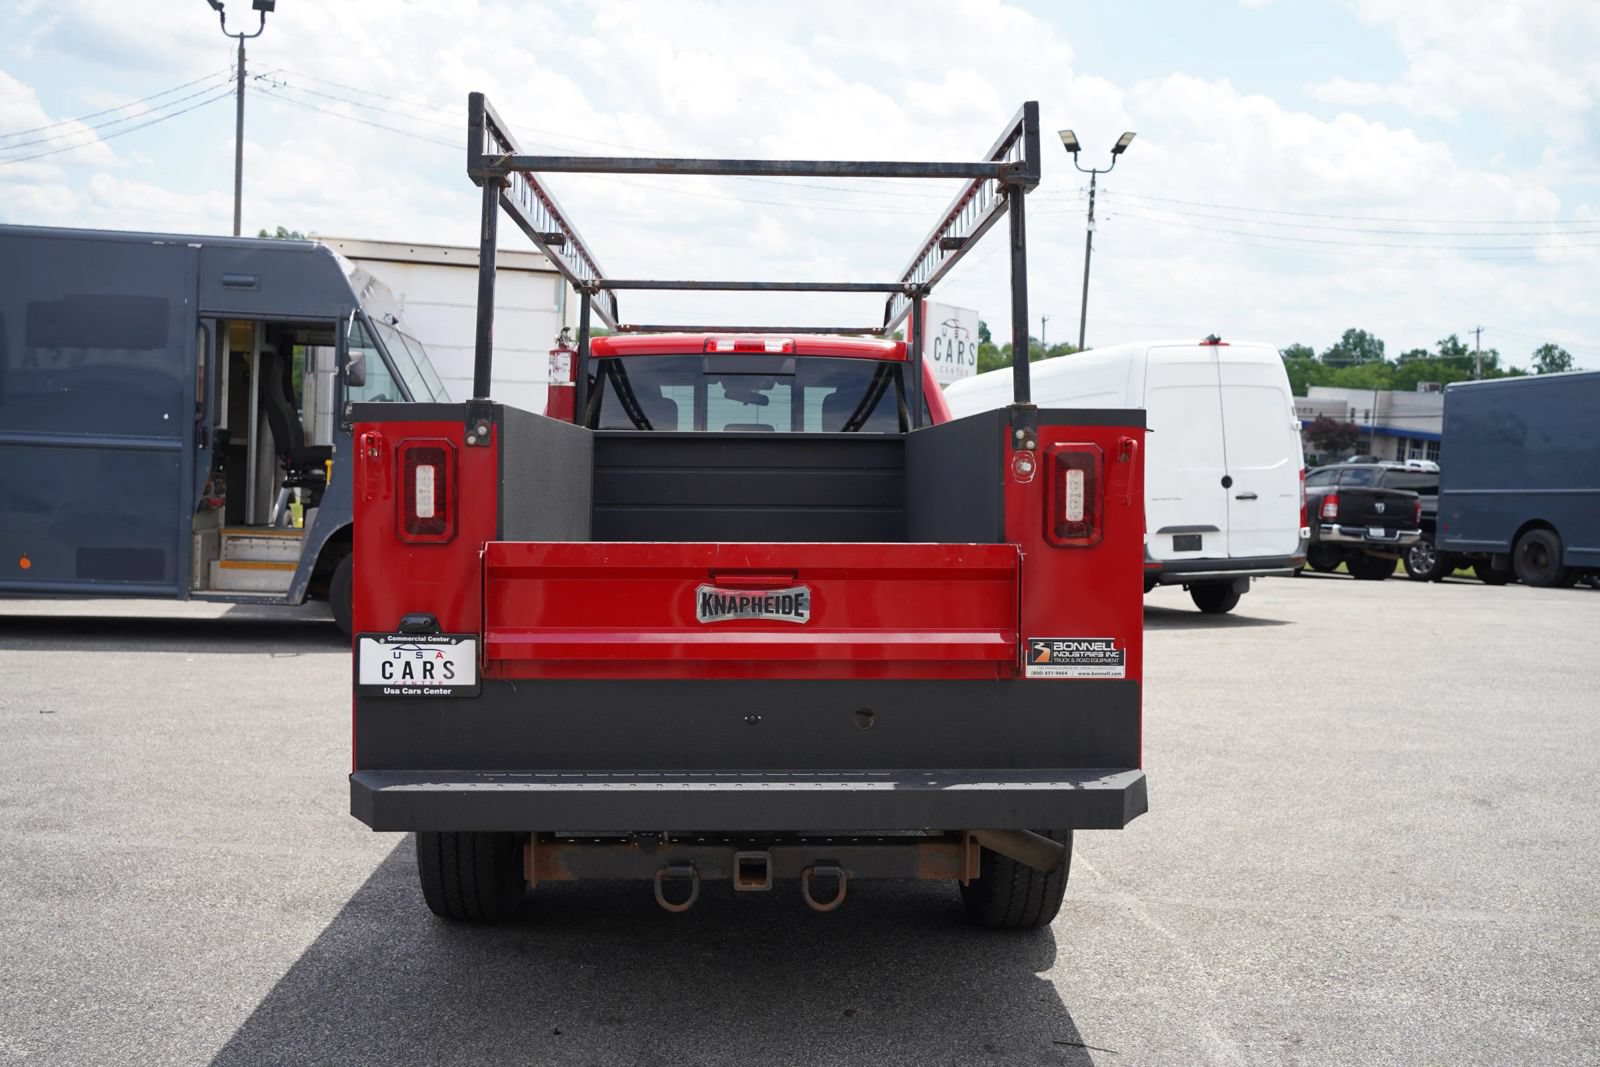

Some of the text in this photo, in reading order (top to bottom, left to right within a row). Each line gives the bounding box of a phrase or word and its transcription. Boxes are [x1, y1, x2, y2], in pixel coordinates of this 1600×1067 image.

[934, 336, 976, 366] CARS
[701, 592, 805, 617] KNAPHEIDE
[1053, 642, 1117, 651] BONNELL
[393, 651, 444, 659] USA
[381, 660, 455, 680] CARS
[383, 687, 400, 695] Usa
[402, 687, 422, 695] Cars
